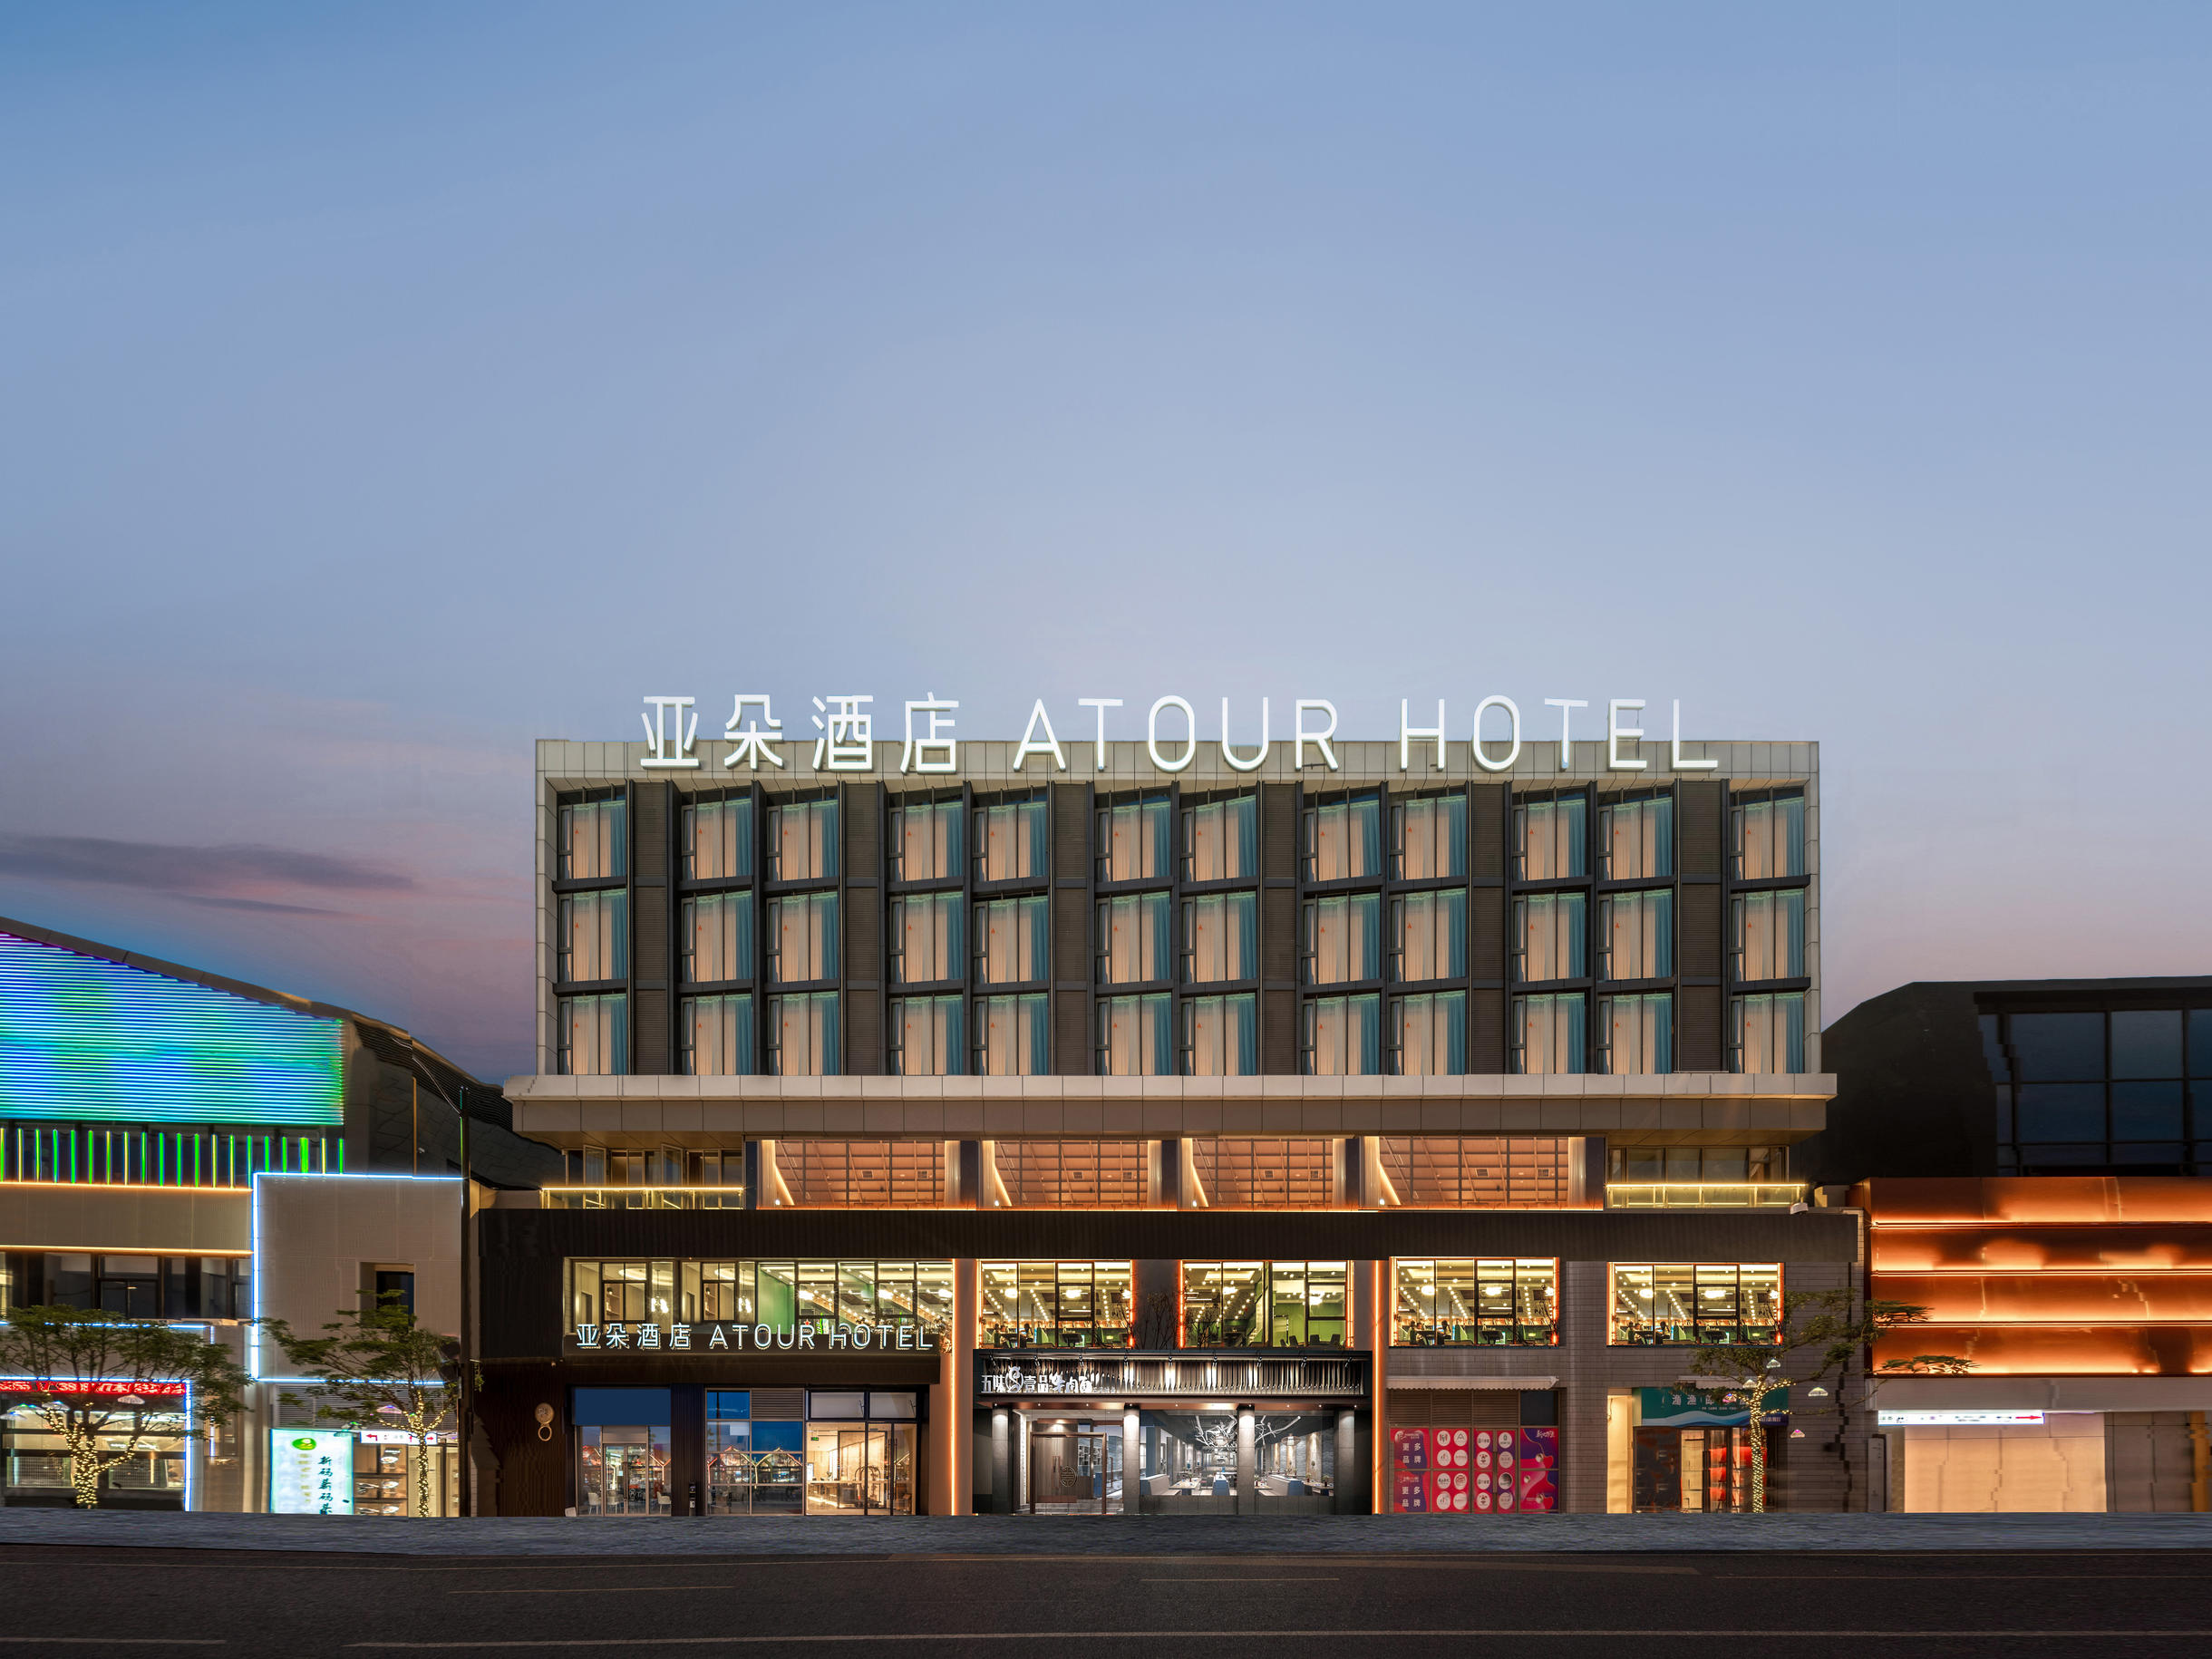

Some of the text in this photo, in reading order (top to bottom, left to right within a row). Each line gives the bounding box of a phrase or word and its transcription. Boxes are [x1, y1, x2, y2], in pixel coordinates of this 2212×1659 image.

[640, 692, 959, 773] 亚朵酒店
[1013, 695, 1718, 772] ATOUR HOTEL
[576, 1323, 692, 1350] 亚朵酒店
[709, 1323, 934, 1350] ATOUR HOTEL
[1402, 1442, 1421, 1451] 更多
[1402, 1455, 1421, 1464] 品牌
[1402, 1486, 1421, 1495] 更多
[1402, 1499, 1421, 1508] 品牌
